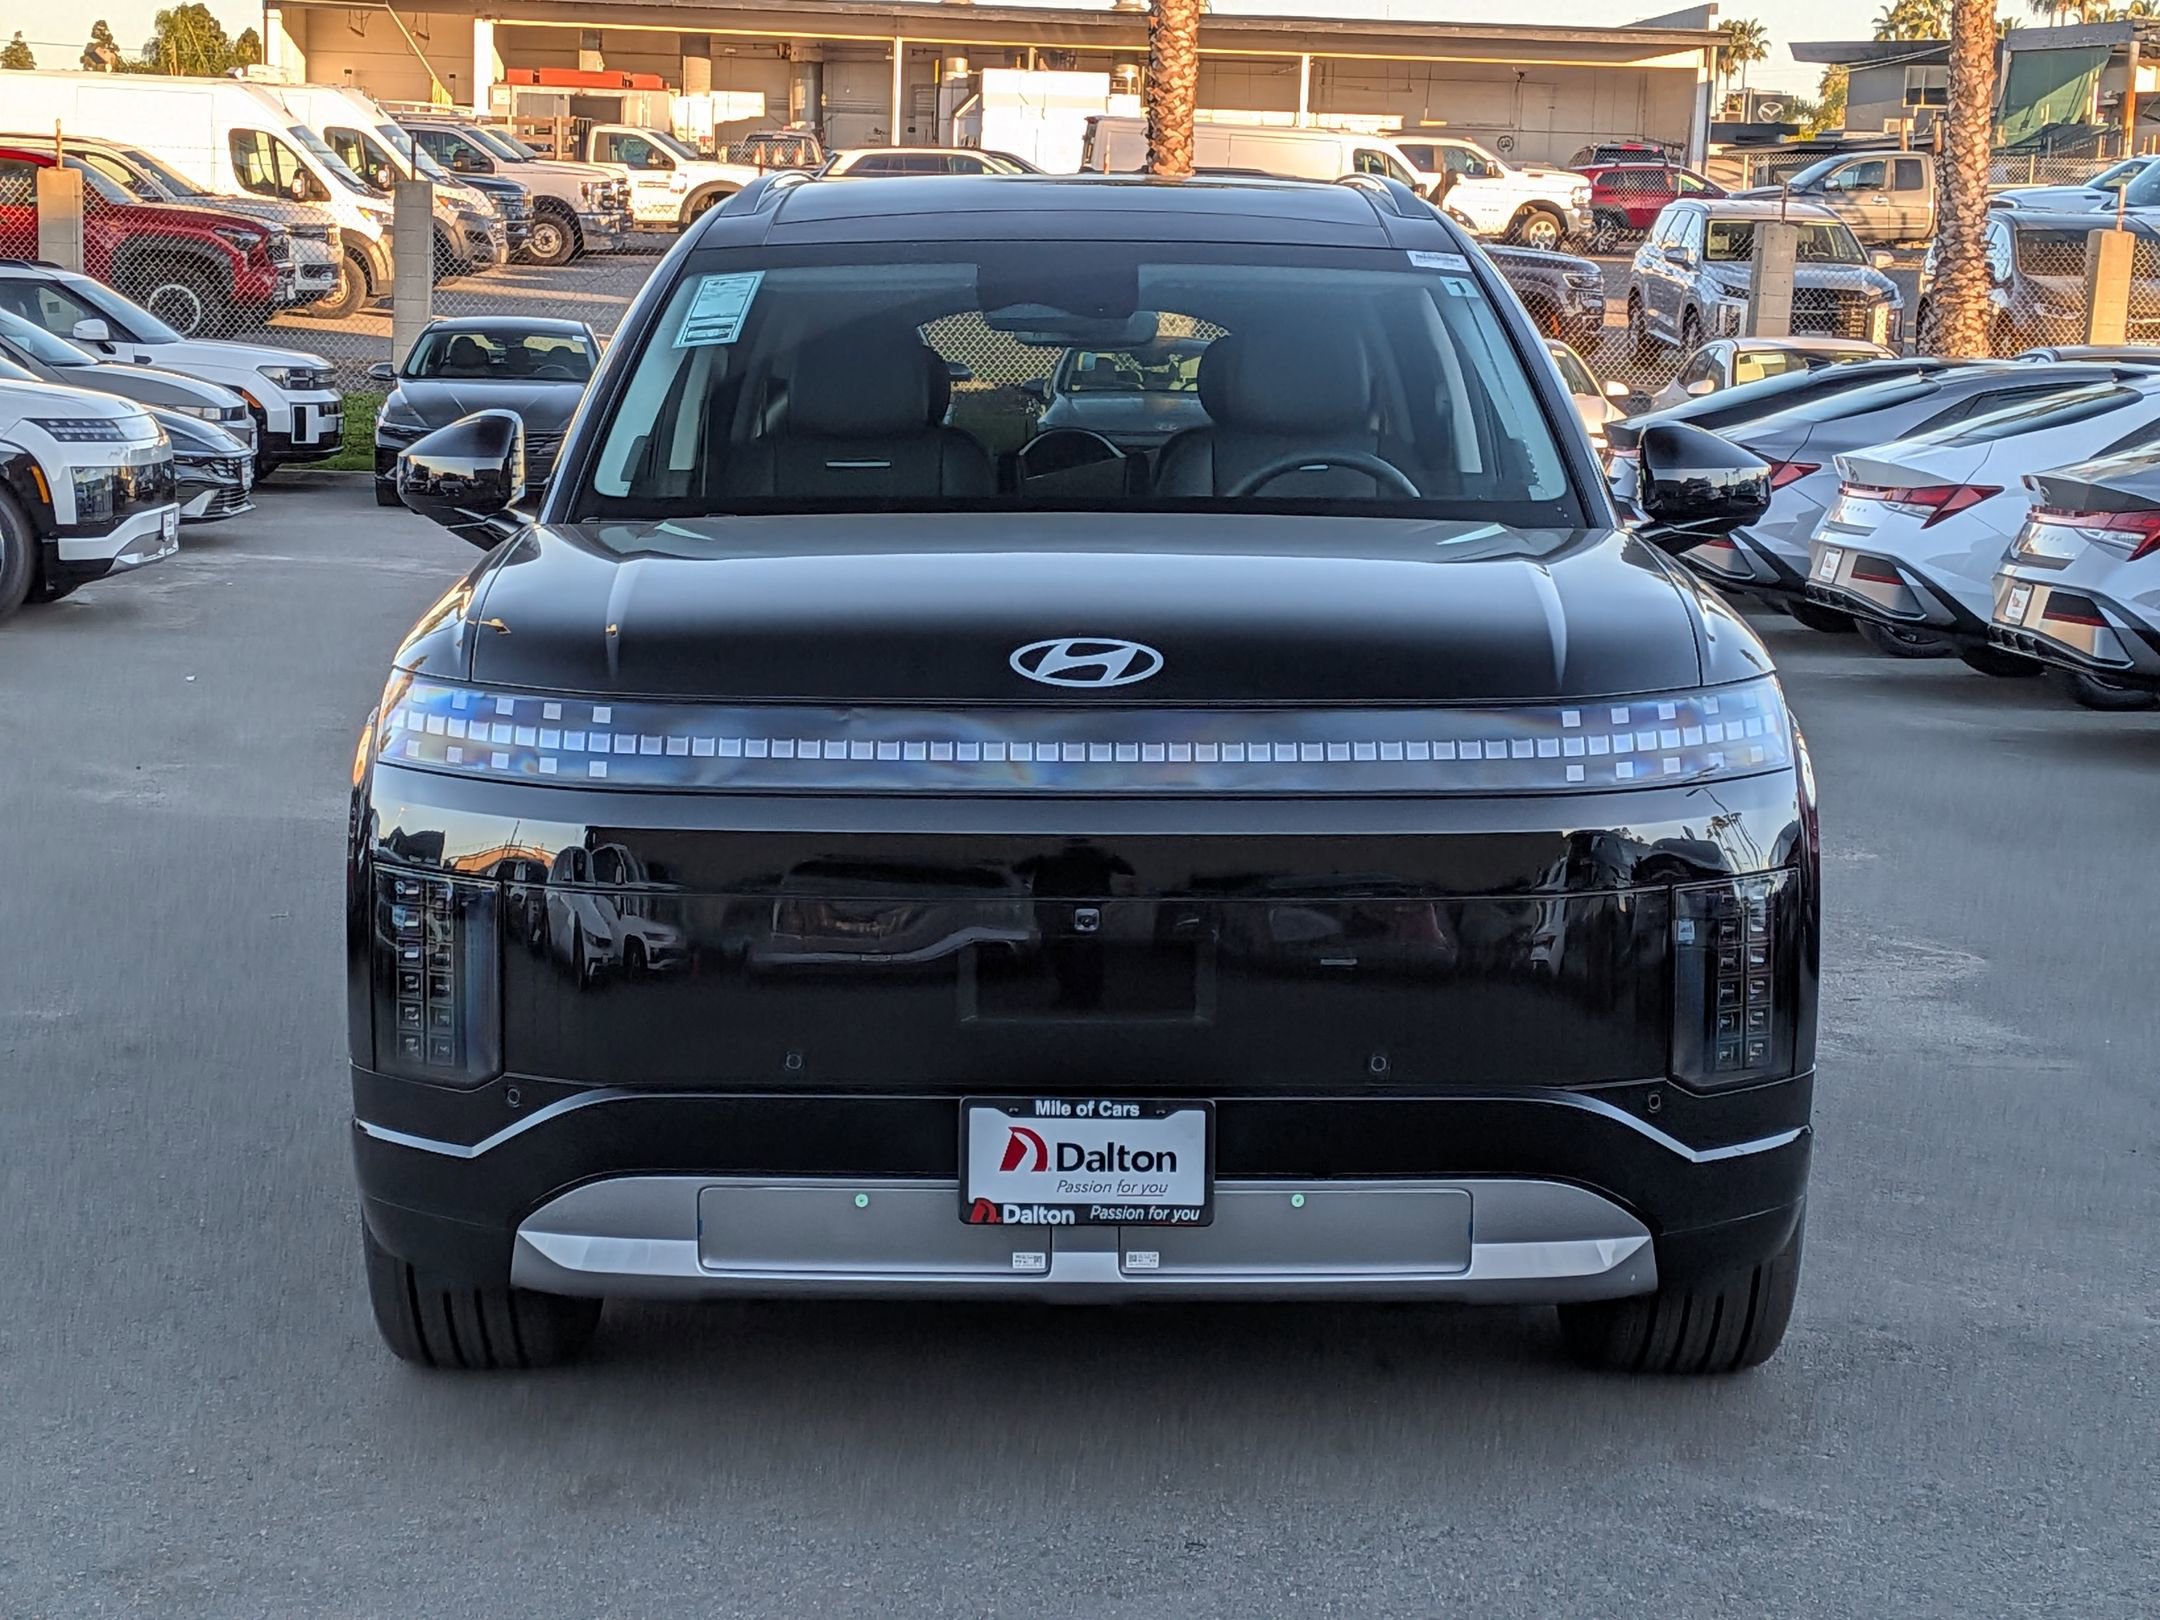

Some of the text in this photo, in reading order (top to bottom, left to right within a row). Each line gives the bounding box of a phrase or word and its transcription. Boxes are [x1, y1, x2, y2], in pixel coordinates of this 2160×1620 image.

[1035, 1100, 1140, 1117] Mile of Cars
[1056, 1141, 1177, 1172] Dalton
[1056, 1179, 1169, 1197] Passion for you
[1002, 1204, 1076, 1225] Dalton
[1090, 1205, 1200, 1223] Passion for you
